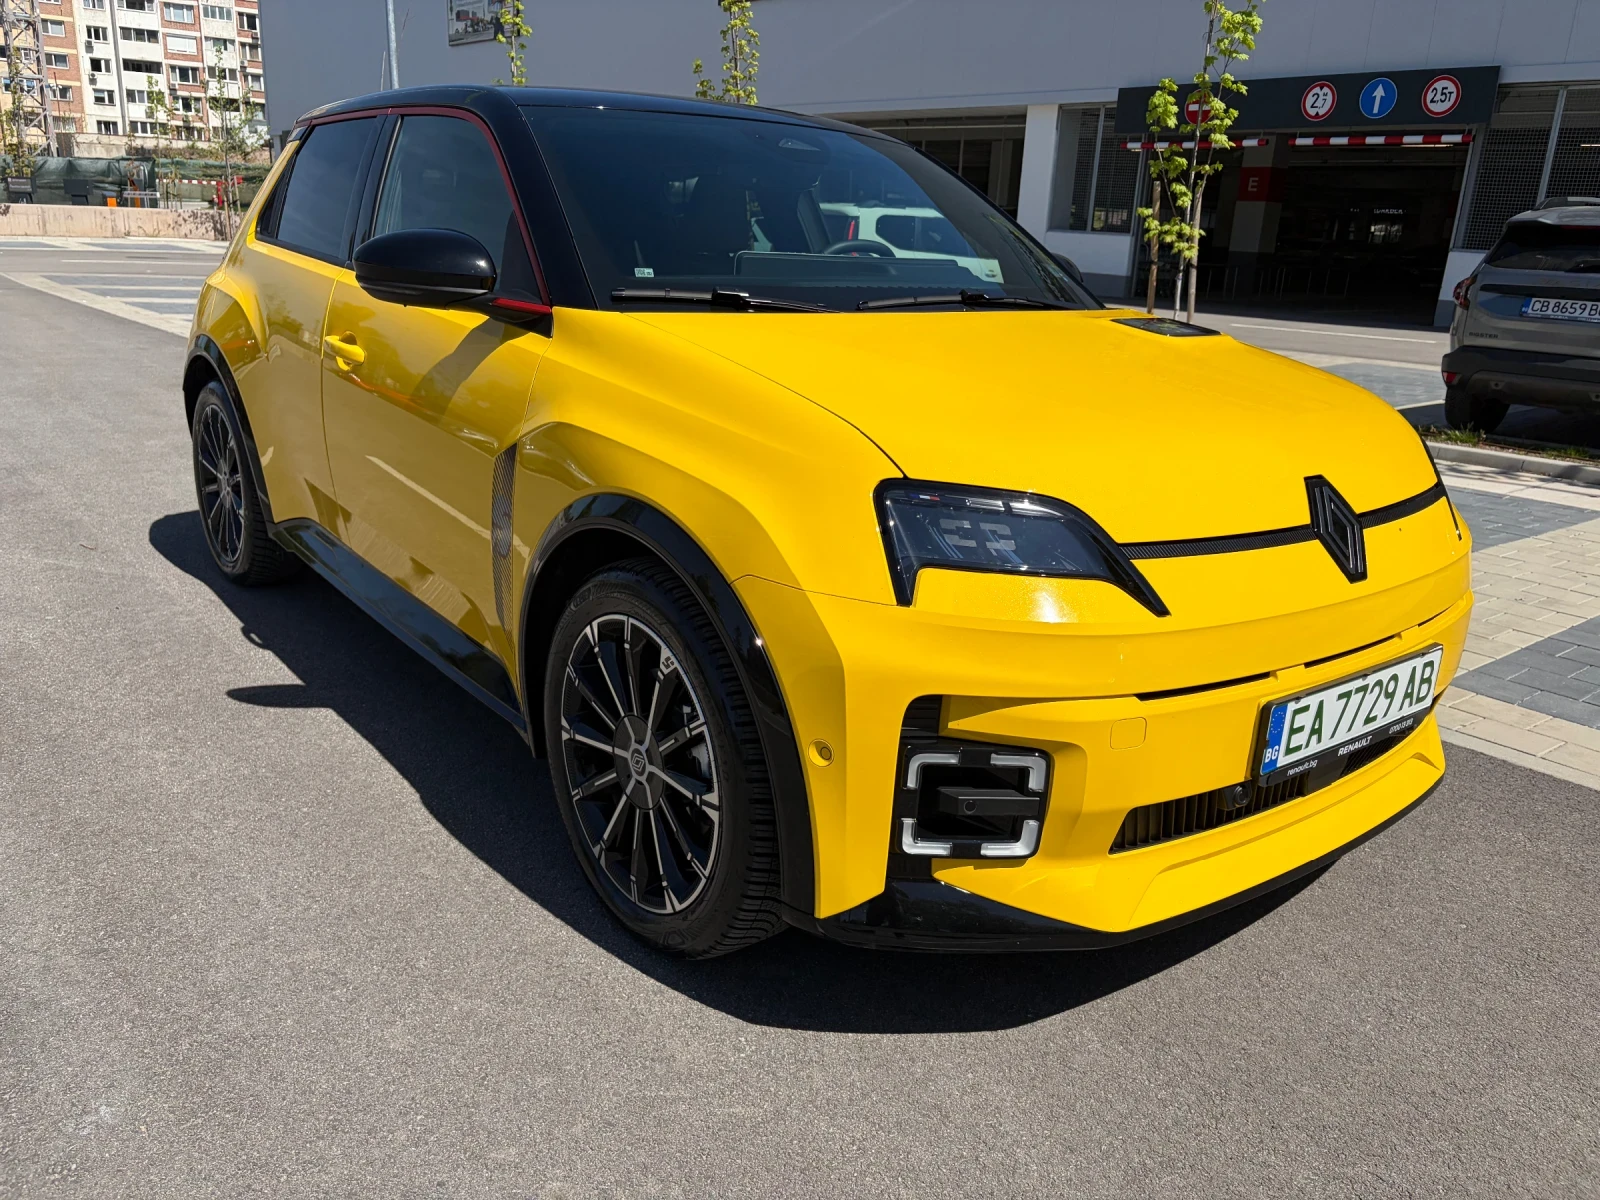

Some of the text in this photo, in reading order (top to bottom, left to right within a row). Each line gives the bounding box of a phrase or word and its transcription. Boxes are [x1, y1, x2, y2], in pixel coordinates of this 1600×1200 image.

[1248, 177, 1259, 191] E
[1531, 300, 1550, 312] CB
[1552, 301, 1588, 315] 8659
[1588, 303, 1600, 317] B
[1283, 659, 1435, 757] EA 7729 AB
[1264, 745, 1279, 764] BG
[1287, 759, 1318, 777] renault.bg
[1337, 735, 1372, 756] RENAULT
